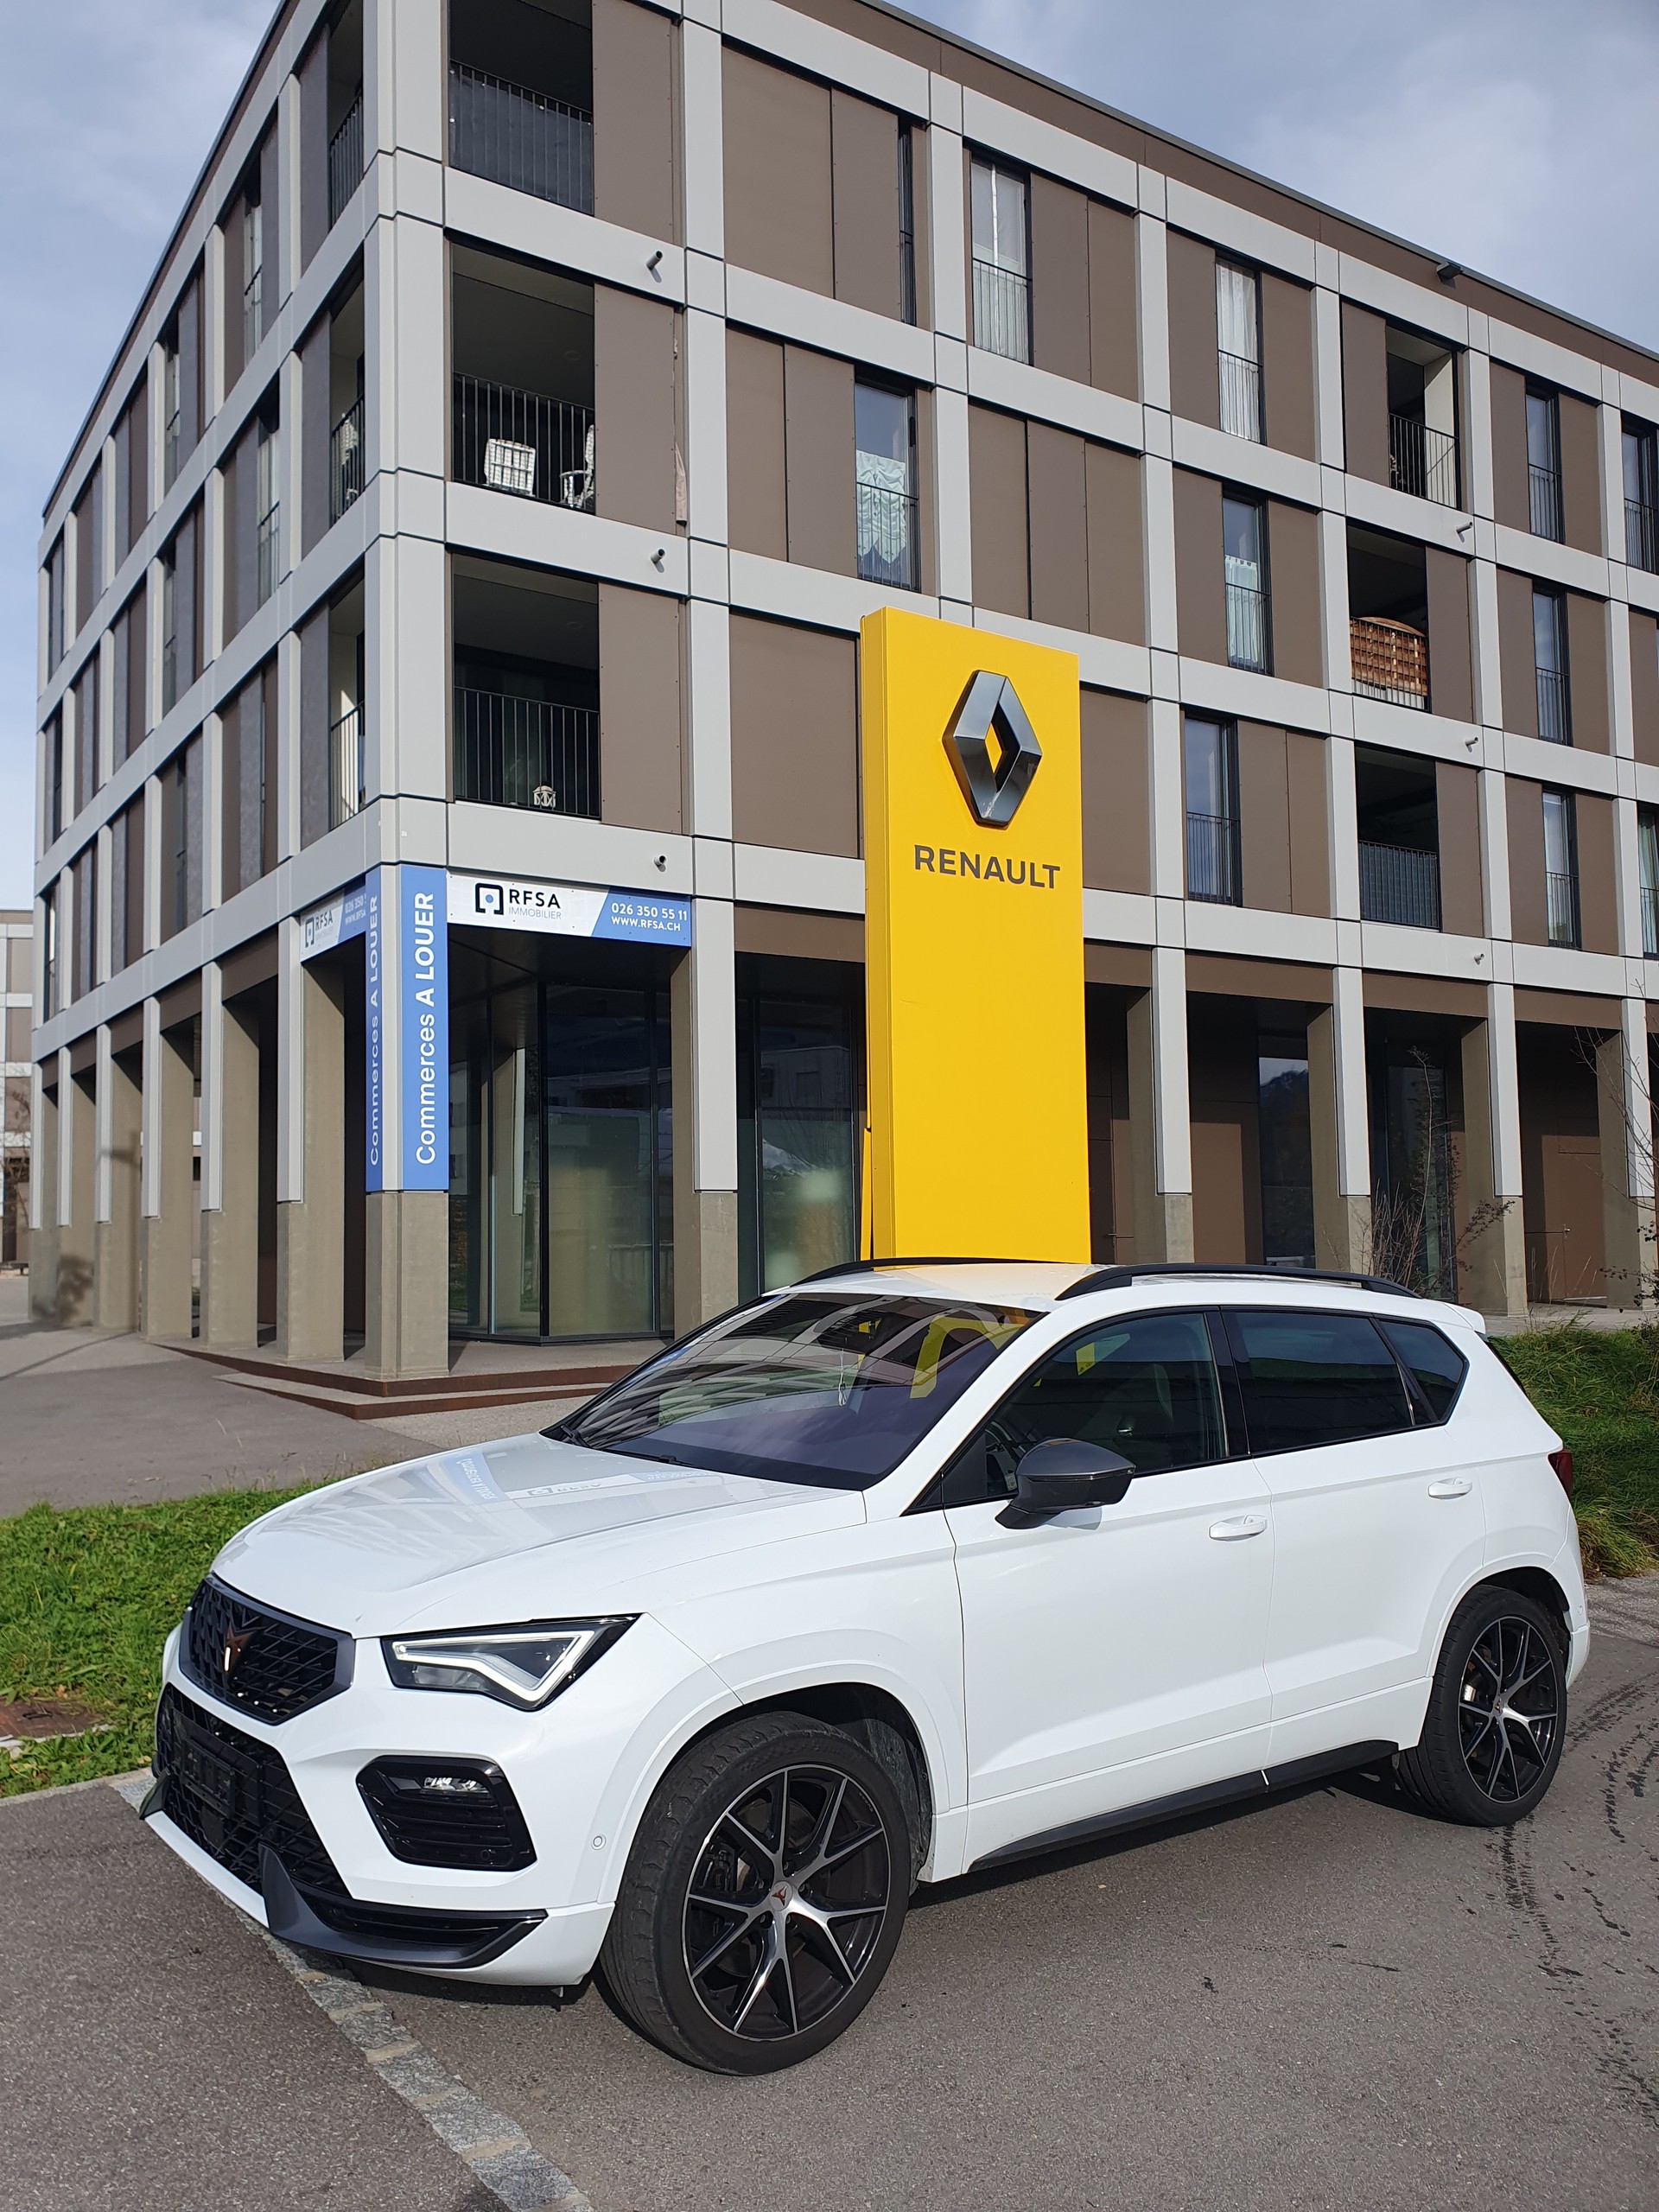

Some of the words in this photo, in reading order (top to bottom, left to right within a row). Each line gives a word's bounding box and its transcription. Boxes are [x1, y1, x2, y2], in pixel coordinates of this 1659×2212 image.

[914, 844, 1061, 890] RENAULT
[509, 888, 562, 909] RFSA
[315, 909, 334, 931] RFSA
[508, 906, 562, 919] IMMOBILIER
[611, 902, 633, 915] 026
[636, 905, 658, 918] 350
[661, 907, 676, 920] 55
[677, 910, 688, 921] 11
[611, 916, 681, 931] WWW.RFSA.CH
[369, 895, 378, 982] LOUER
[414, 893, 435, 981] LOUER
[370, 988, 378, 1007] A
[415, 987, 435, 1007] A
[370, 1014, 378, 1166] Commerces
[416, 1014, 436, 1165] Commerces
